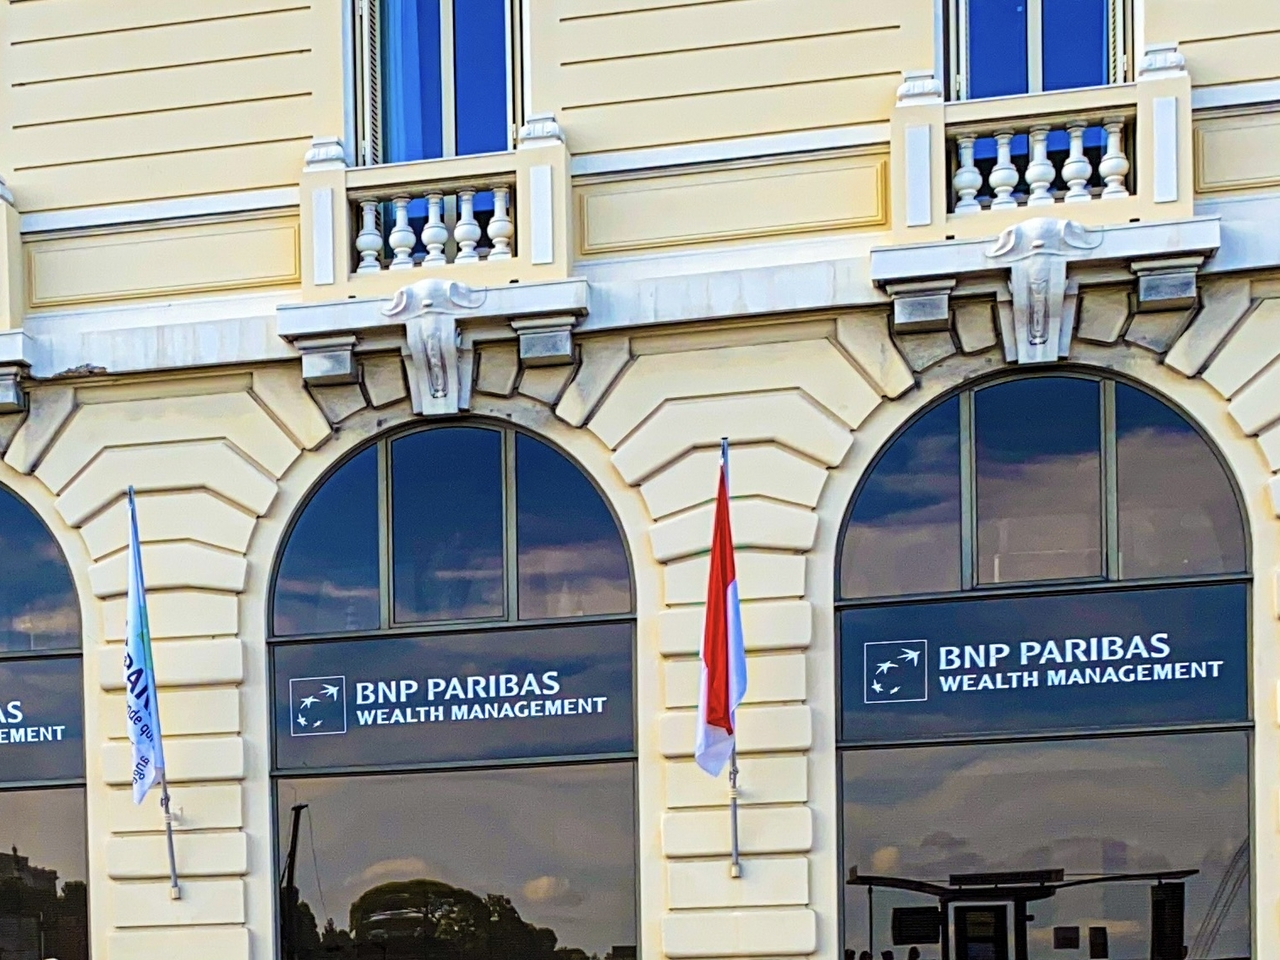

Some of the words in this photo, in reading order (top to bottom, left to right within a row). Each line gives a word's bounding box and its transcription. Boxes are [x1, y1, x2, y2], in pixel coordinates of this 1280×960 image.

[939, 643, 1011, 670] BNP
[1020, 633, 1170, 665] PARIBAS
[356, 680, 418, 704] BNP
[427, 671, 560, 700] PARIBAS
[939, 670, 1039, 692] WEALTH
[1047, 661, 1224, 686] MANAGEMENT
[356, 706, 443, 725] WEALTH
[451, 697, 607, 720] MANAGEMENT
